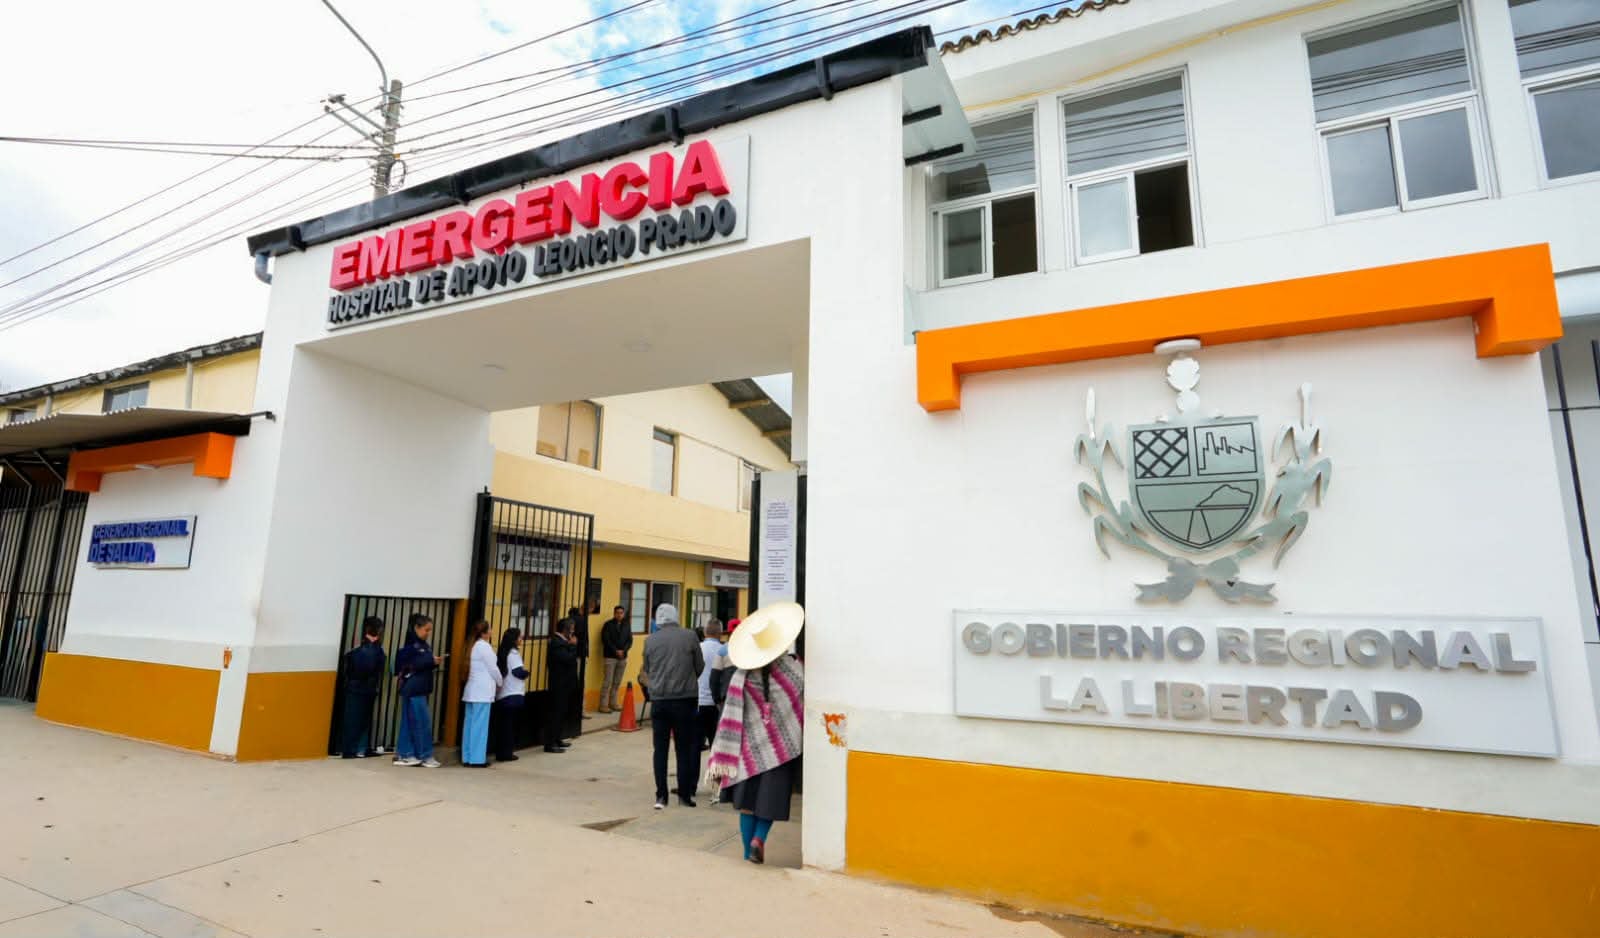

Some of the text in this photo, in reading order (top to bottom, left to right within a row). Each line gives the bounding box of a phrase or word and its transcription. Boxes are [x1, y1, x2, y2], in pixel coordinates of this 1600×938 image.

[330, 139, 730, 291] EMERGENCIA
[328, 199, 737, 323] HOSPITAL DE APOYO LEONCIO PRADO
[88, 542, 106, 562] DE
[93, 520, 189, 540] GERENCIA REGIONAL
[961, 621, 1537, 674] GOBIERNO REGIONAL
[1040, 675, 1424, 733] LA LIBERTAD
